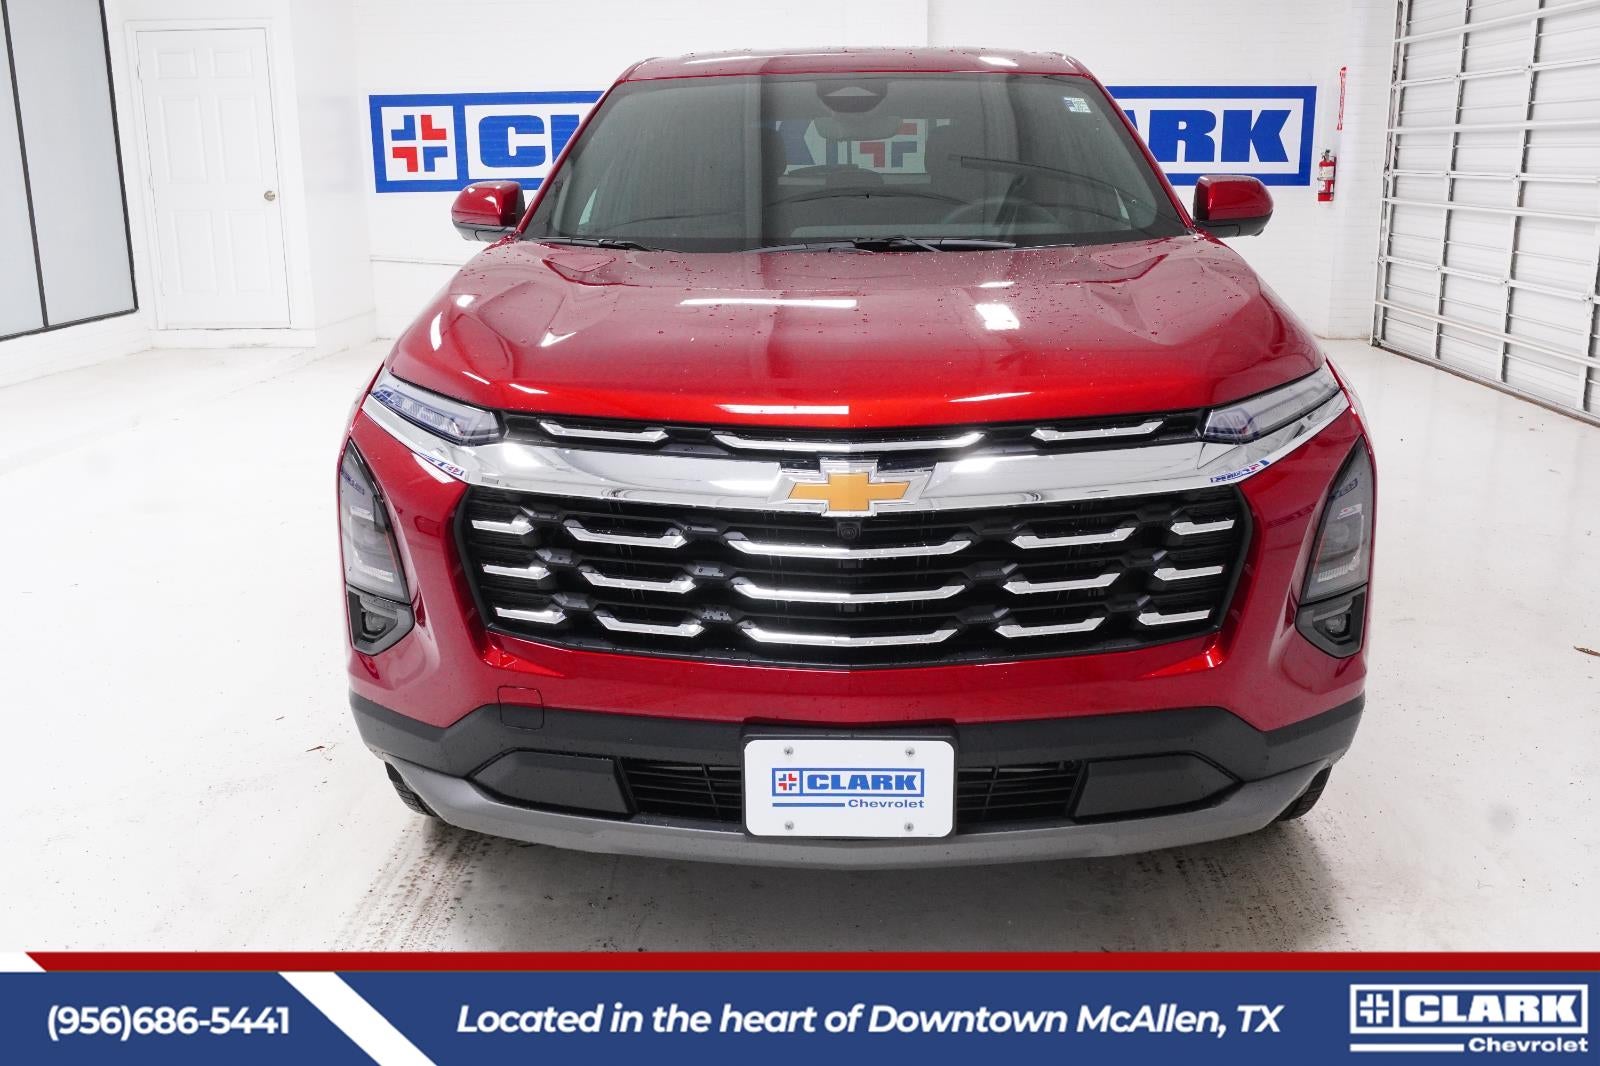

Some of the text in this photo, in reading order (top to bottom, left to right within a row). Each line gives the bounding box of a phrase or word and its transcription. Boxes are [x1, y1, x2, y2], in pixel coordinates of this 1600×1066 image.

[1124, 109, 1292, 163] RK
[807, 774, 917, 791] CLARK
[848, 799, 925, 808] Chevrolet
